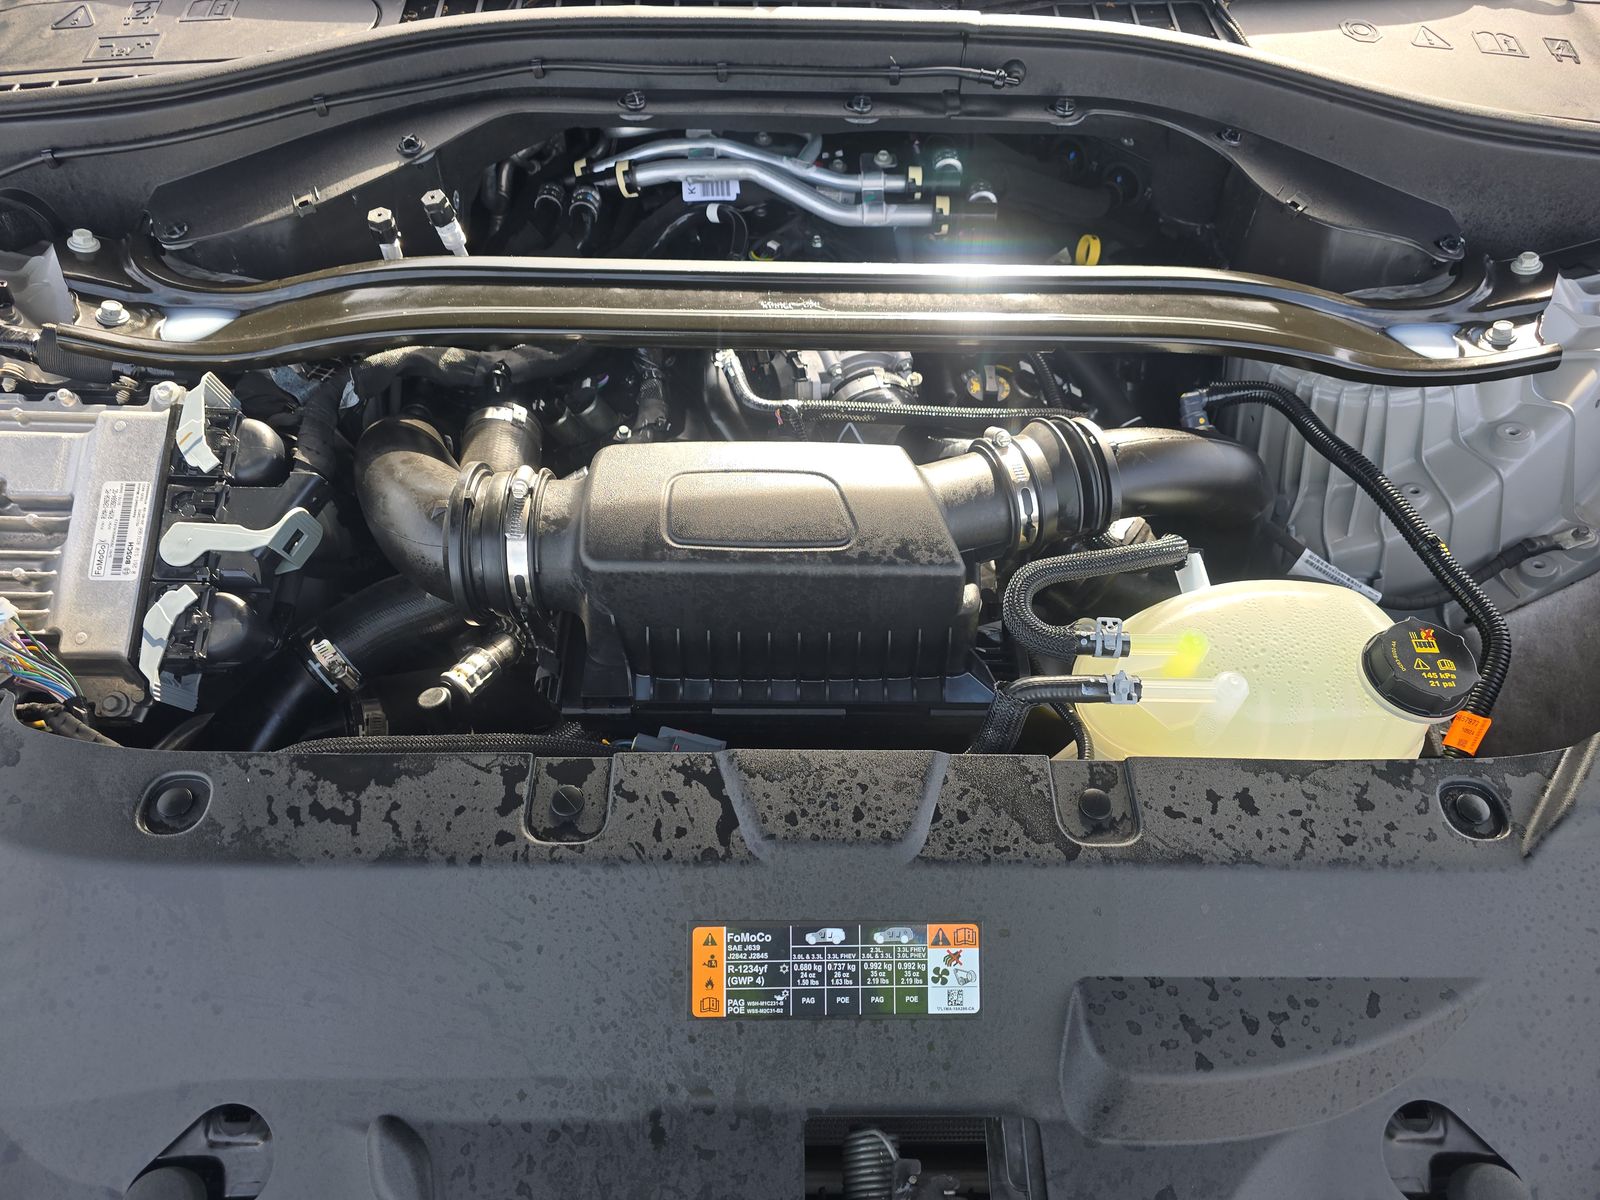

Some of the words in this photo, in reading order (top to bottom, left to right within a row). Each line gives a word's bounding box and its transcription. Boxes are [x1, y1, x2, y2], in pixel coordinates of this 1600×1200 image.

[125, 542, 134, 564] BOSCH
[94, 544, 106, 575] FoMoCo
[727, 932, 772, 942] FoMoCo
[728, 965, 768, 975] R-1234yf
[814, 963, 822, 972] kg
[847, 963, 856, 972] kg
[884, 962, 892, 971] kg
[917, 962, 926, 971] kg
[728, 977, 754, 986] (GWP
[756, 976, 765, 986] 4)
